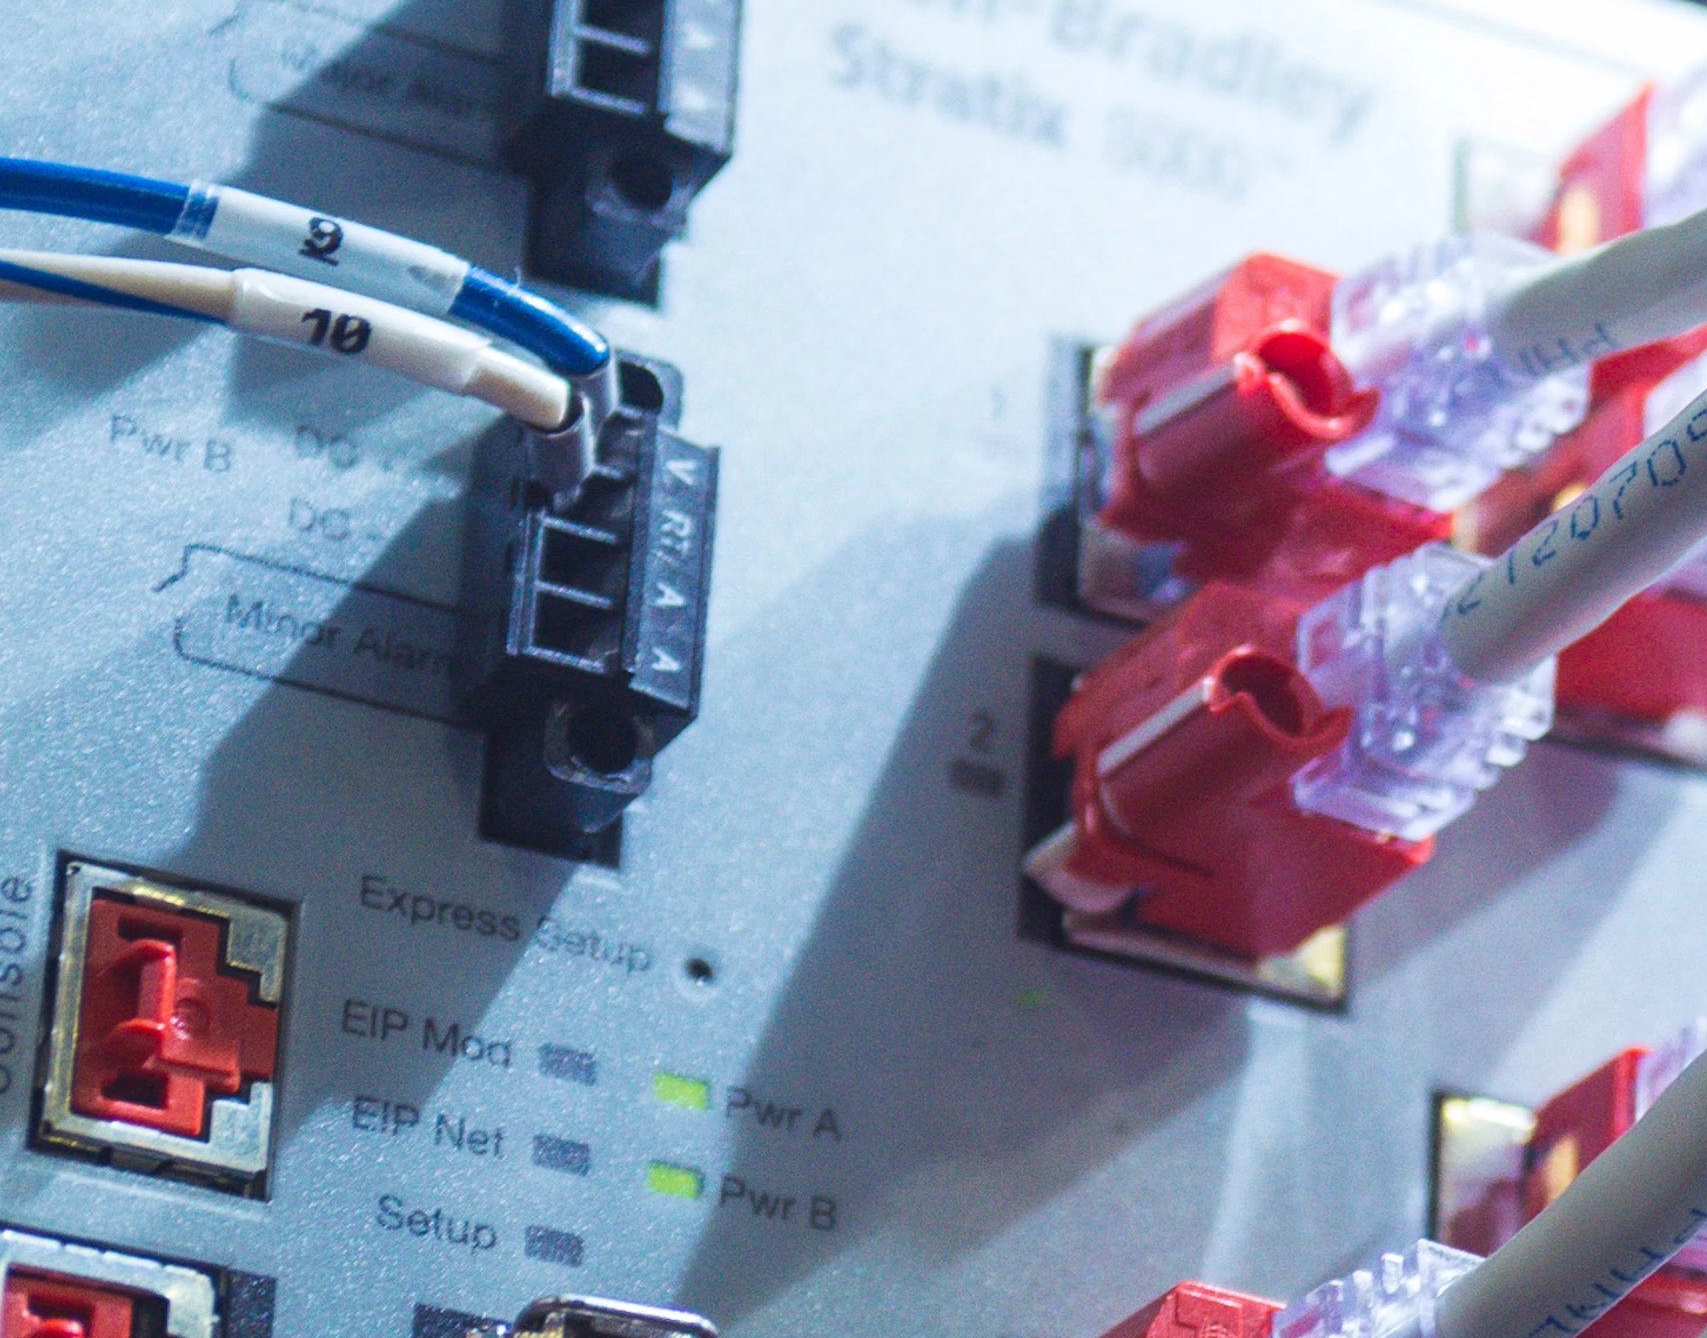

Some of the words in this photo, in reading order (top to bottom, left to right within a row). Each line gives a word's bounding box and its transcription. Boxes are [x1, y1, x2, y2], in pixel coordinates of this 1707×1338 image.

[299, 216, 347, 265] 9
[300, 306, 373, 356] 10
[109, 413, 191, 462] Pwr
[203, 438, 233, 473] B
[359, 874, 522, 944] Express
[536, 914, 657, 978] Setup
[433, 1109, 507, 1159] Net
[723, 1085, 804, 1136] Pwr
[811, 1105, 843, 1144] A
[376, 1191, 500, 1255] Setup
[719, 1174, 801, 1223] Pwr
[809, 1190, 839, 1232] B
